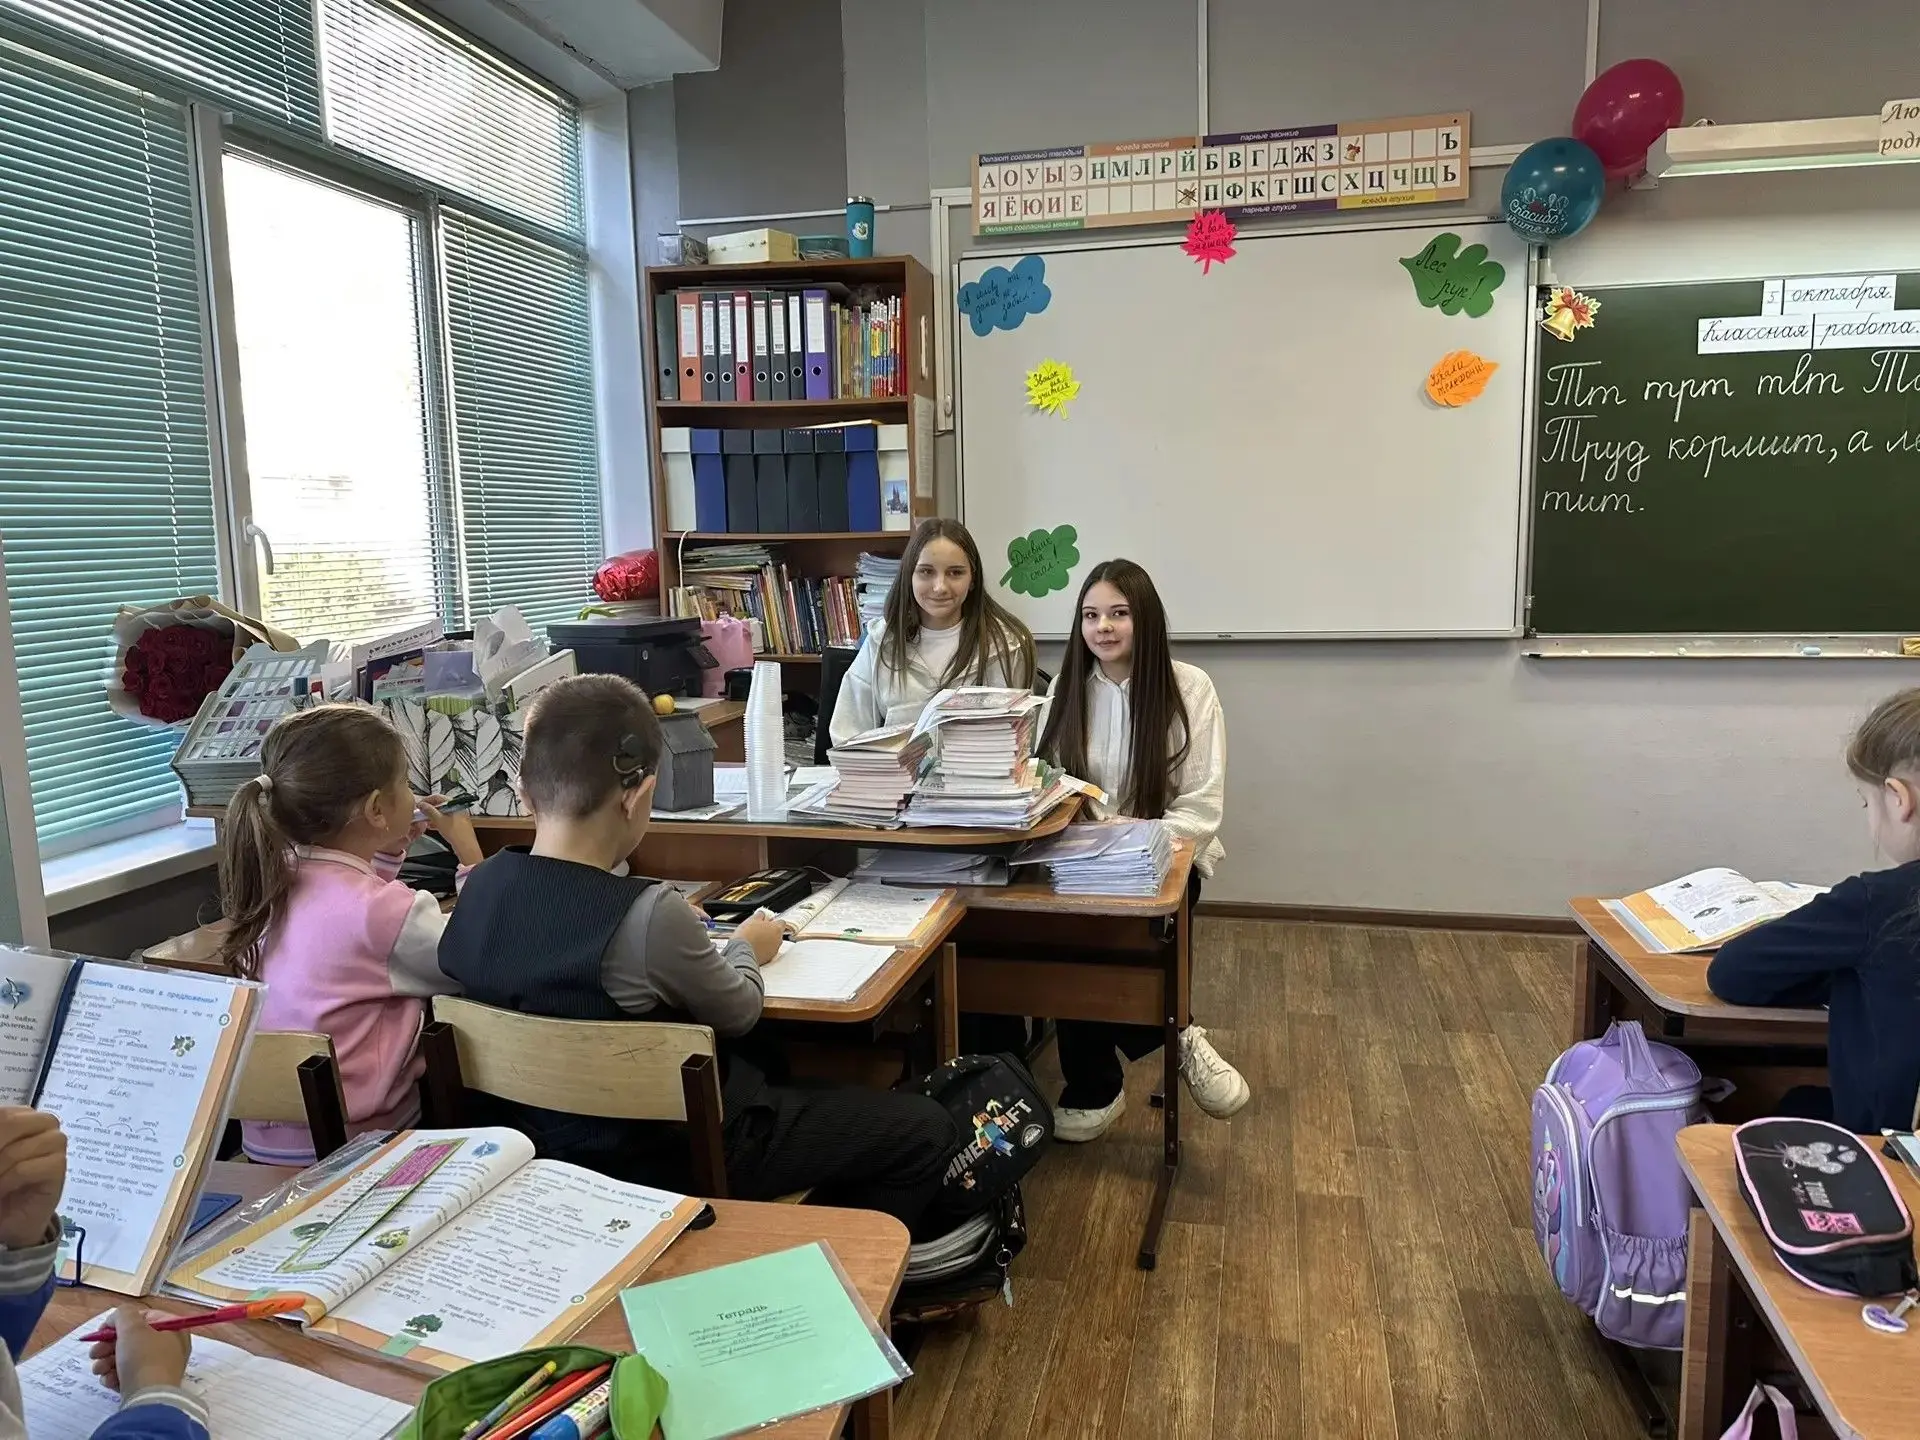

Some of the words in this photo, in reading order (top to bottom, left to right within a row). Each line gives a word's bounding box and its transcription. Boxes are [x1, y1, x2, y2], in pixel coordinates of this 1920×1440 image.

[1239, 132, 1269, 142] парные
[1270, 129, 1300, 139] звонкие
[980, 154, 1009, 163] делают
[1010, 150, 1048, 161] согласный
[982, 172, 996, 188] А
[1004, 169, 1018, 187] О
[1026, 167, 1040, 185] У
[1045, 166, 1063, 184] Ы
[1070, 164, 1083, 182] Э
[1091, 162, 1106, 180] Н
[1112, 160, 1129, 178] М
[1135, 158, 1150, 176] Л
[1160, 156, 1172, 174] Р
[1180, 150, 1196, 172] Й
[1205, 154, 1219, 171] Б
[1228, 151, 1241, 168] В
[1251, 149, 1265, 167] Г
[1273, 147, 1289, 167] Д
[1294, 145, 1316, 163] Ж
[1322, 143, 1334, 161] З
[1441, 132, 1458, 151] Ъ
[982, 201, 996, 218] Я
[1005, 196, 1016, 217] Ё
[1023, 197, 1043, 215] Ю
[1047, 196, 1061, 213] И
[1071, 194, 1083, 212] Е
[1204, 184, 1219, 201] П
[1225, 182, 1244, 200] Ф
[1251, 180, 1265, 198] К
[1274, 179, 1288, 196] Т
[1294, 176, 1316, 194] Ш
[1321, 174, 1336, 193] С
[1343, 172, 1360, 191] Х
[1368, 170, 1385, 192] Ц
[1392, 169, 1407, 186] Ч
[1414, 166, 1437, 186] Щ
[1442, 165, 1456, 183] Ь
[1242, 205, 1270, 215] парные
[1271, 203, 1297, 213] глухие
[985, 225, 1013, 233] делают
[1014, 222, 1051, 232] согласный
[1194, 220, 1204, 236] Я
[1416, 244, 1446, 274] Лес
[1428, 275, 1485, 307] рук!
[1766, 289, 1779, 304] 5
[1791, 276, 1893, 309] октября.
[1702, 319, 1809, 343] Классная
[1820, 312, 1920, 346] работа.
[1544, 360, 1627, 407] Тт
[1643, 378, 1735, 423] трт
[1756, 352, 1844, 396] твт
[1541, 414, 1651, 482] Труд
[1667, 431, 1840, 478] кормит,
[1846, 429, 1873, 452] а
[1541, 489, 1645, 514] тит.
[716, 1304, 768, 1321] Тетрадь
